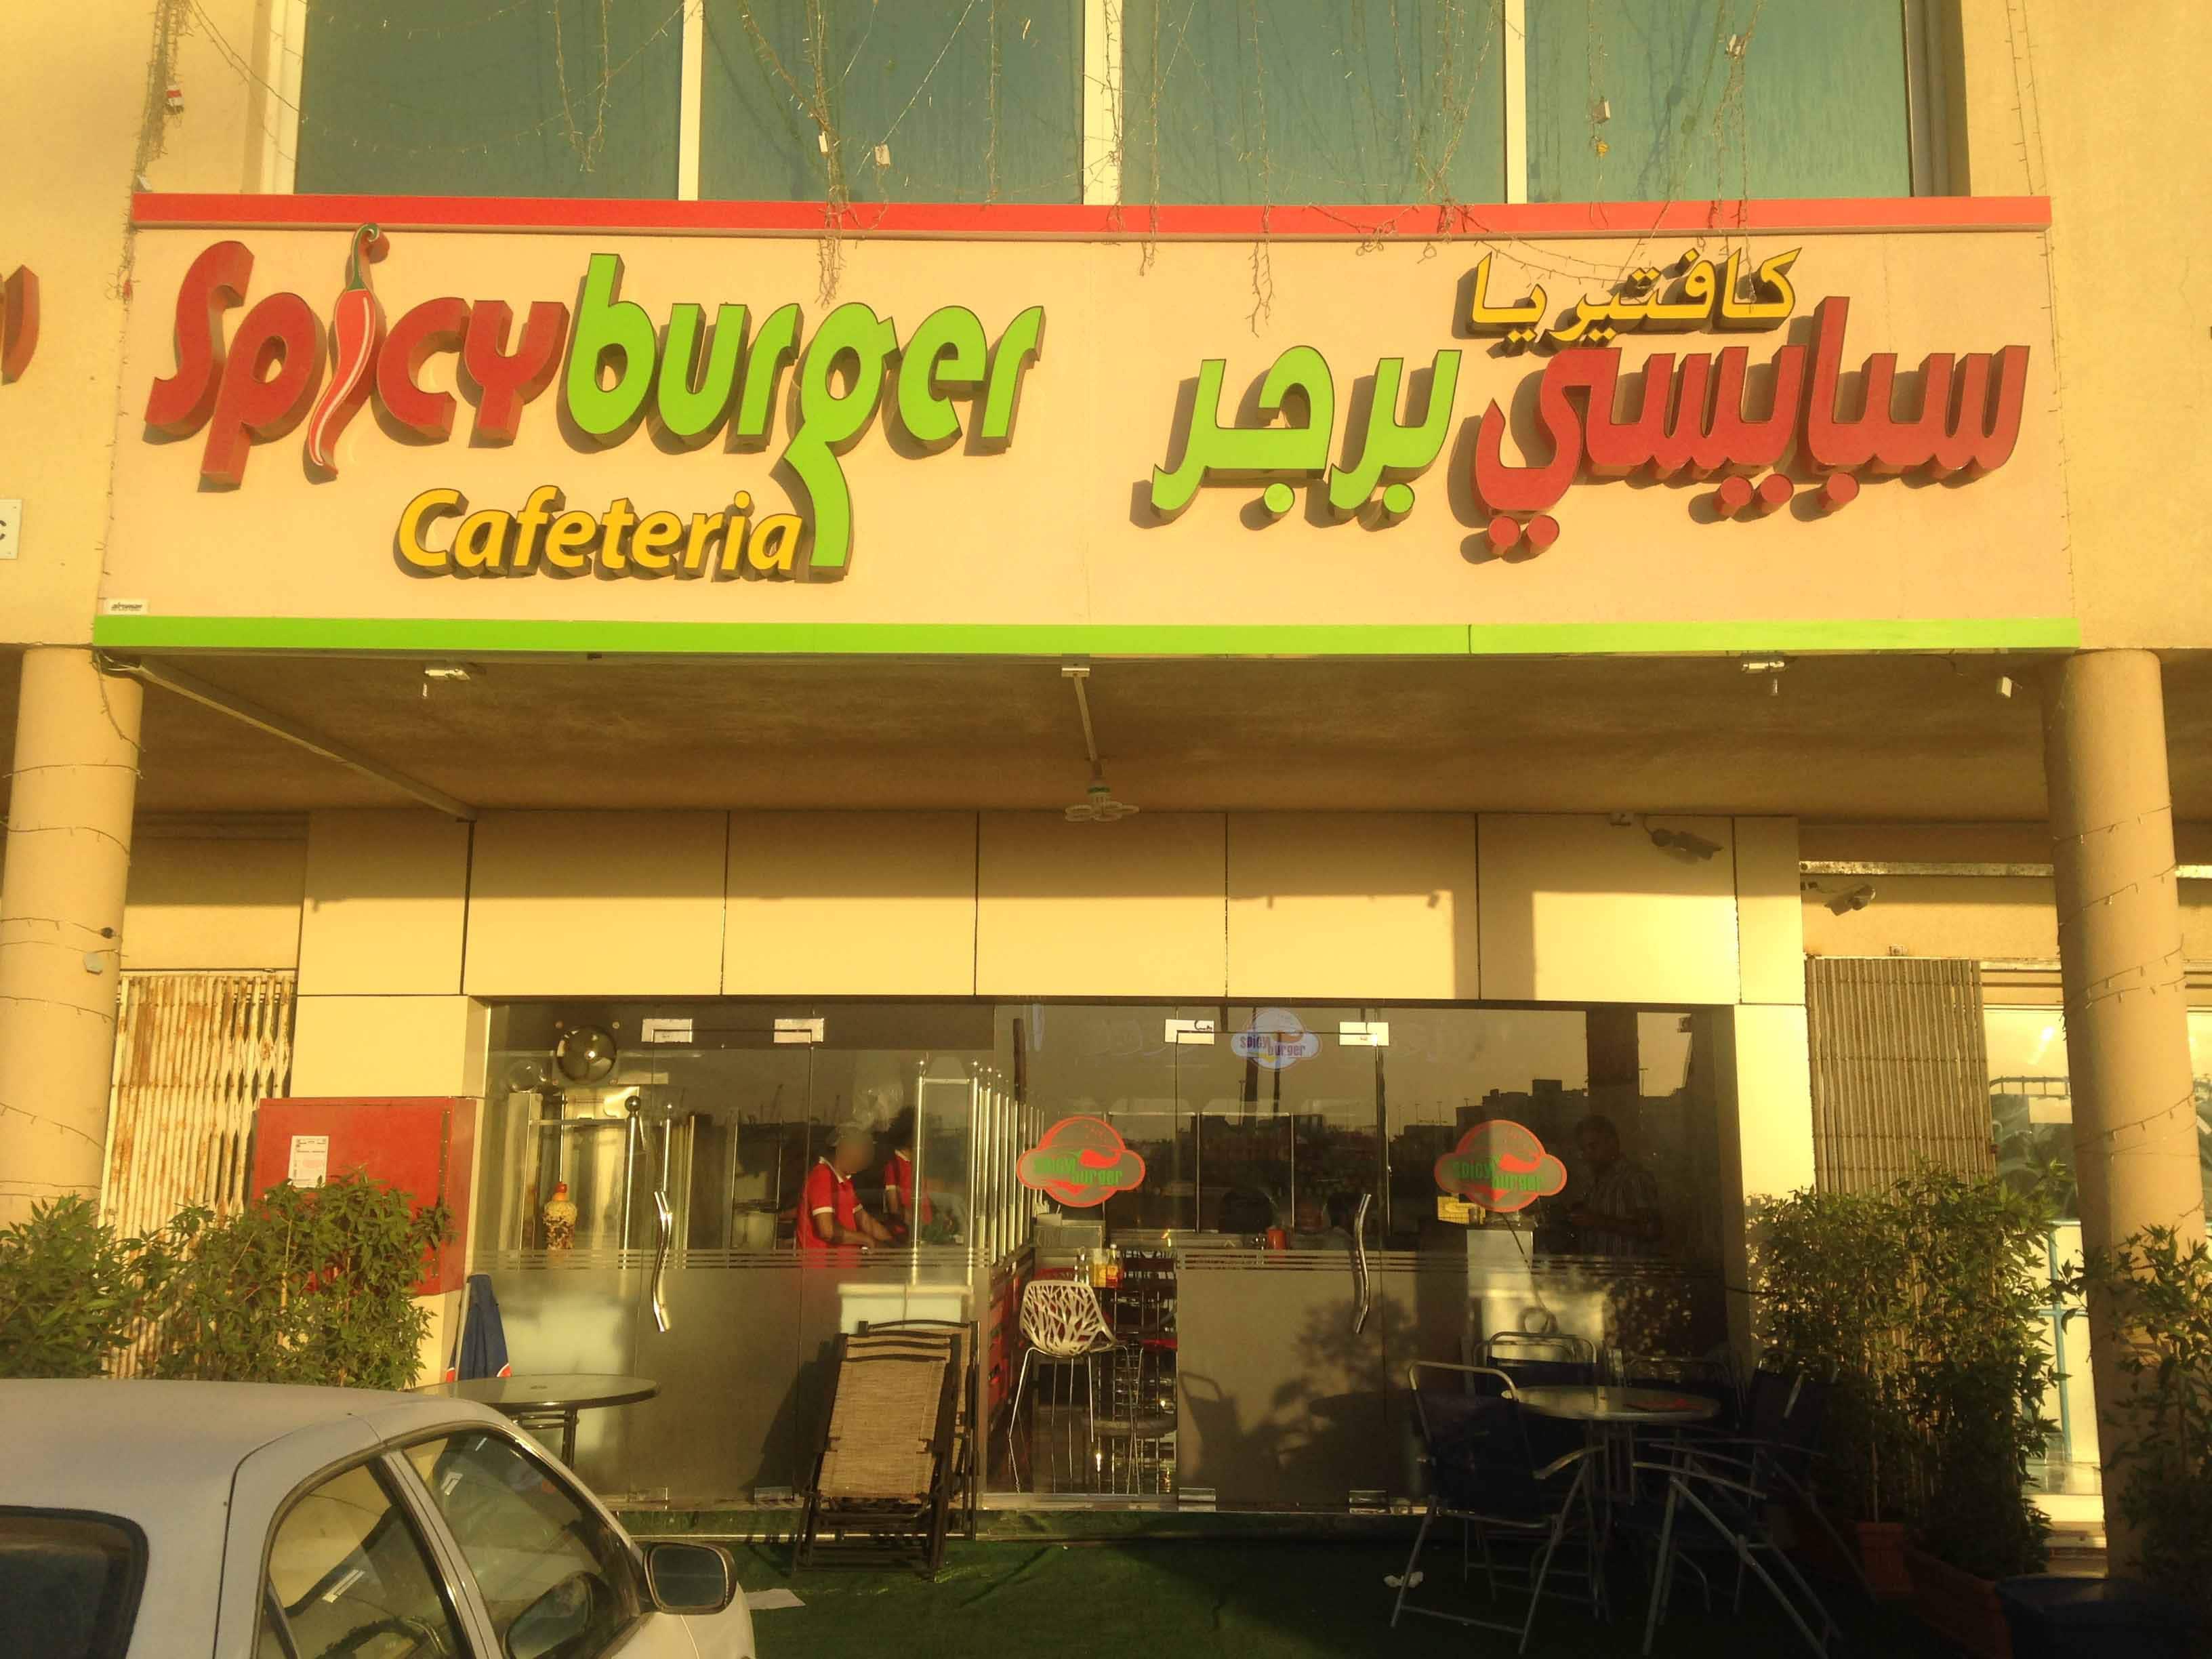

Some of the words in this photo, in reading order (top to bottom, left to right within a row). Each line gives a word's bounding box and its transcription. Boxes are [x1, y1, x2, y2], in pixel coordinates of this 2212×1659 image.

[1469, 246, 1803, 346] كافتيريا
[1151, 344, 1462, 519] برجر
[1475, 295, 2032, 554] سبايسي
[396, 484, 805, 575] Cafeteria
